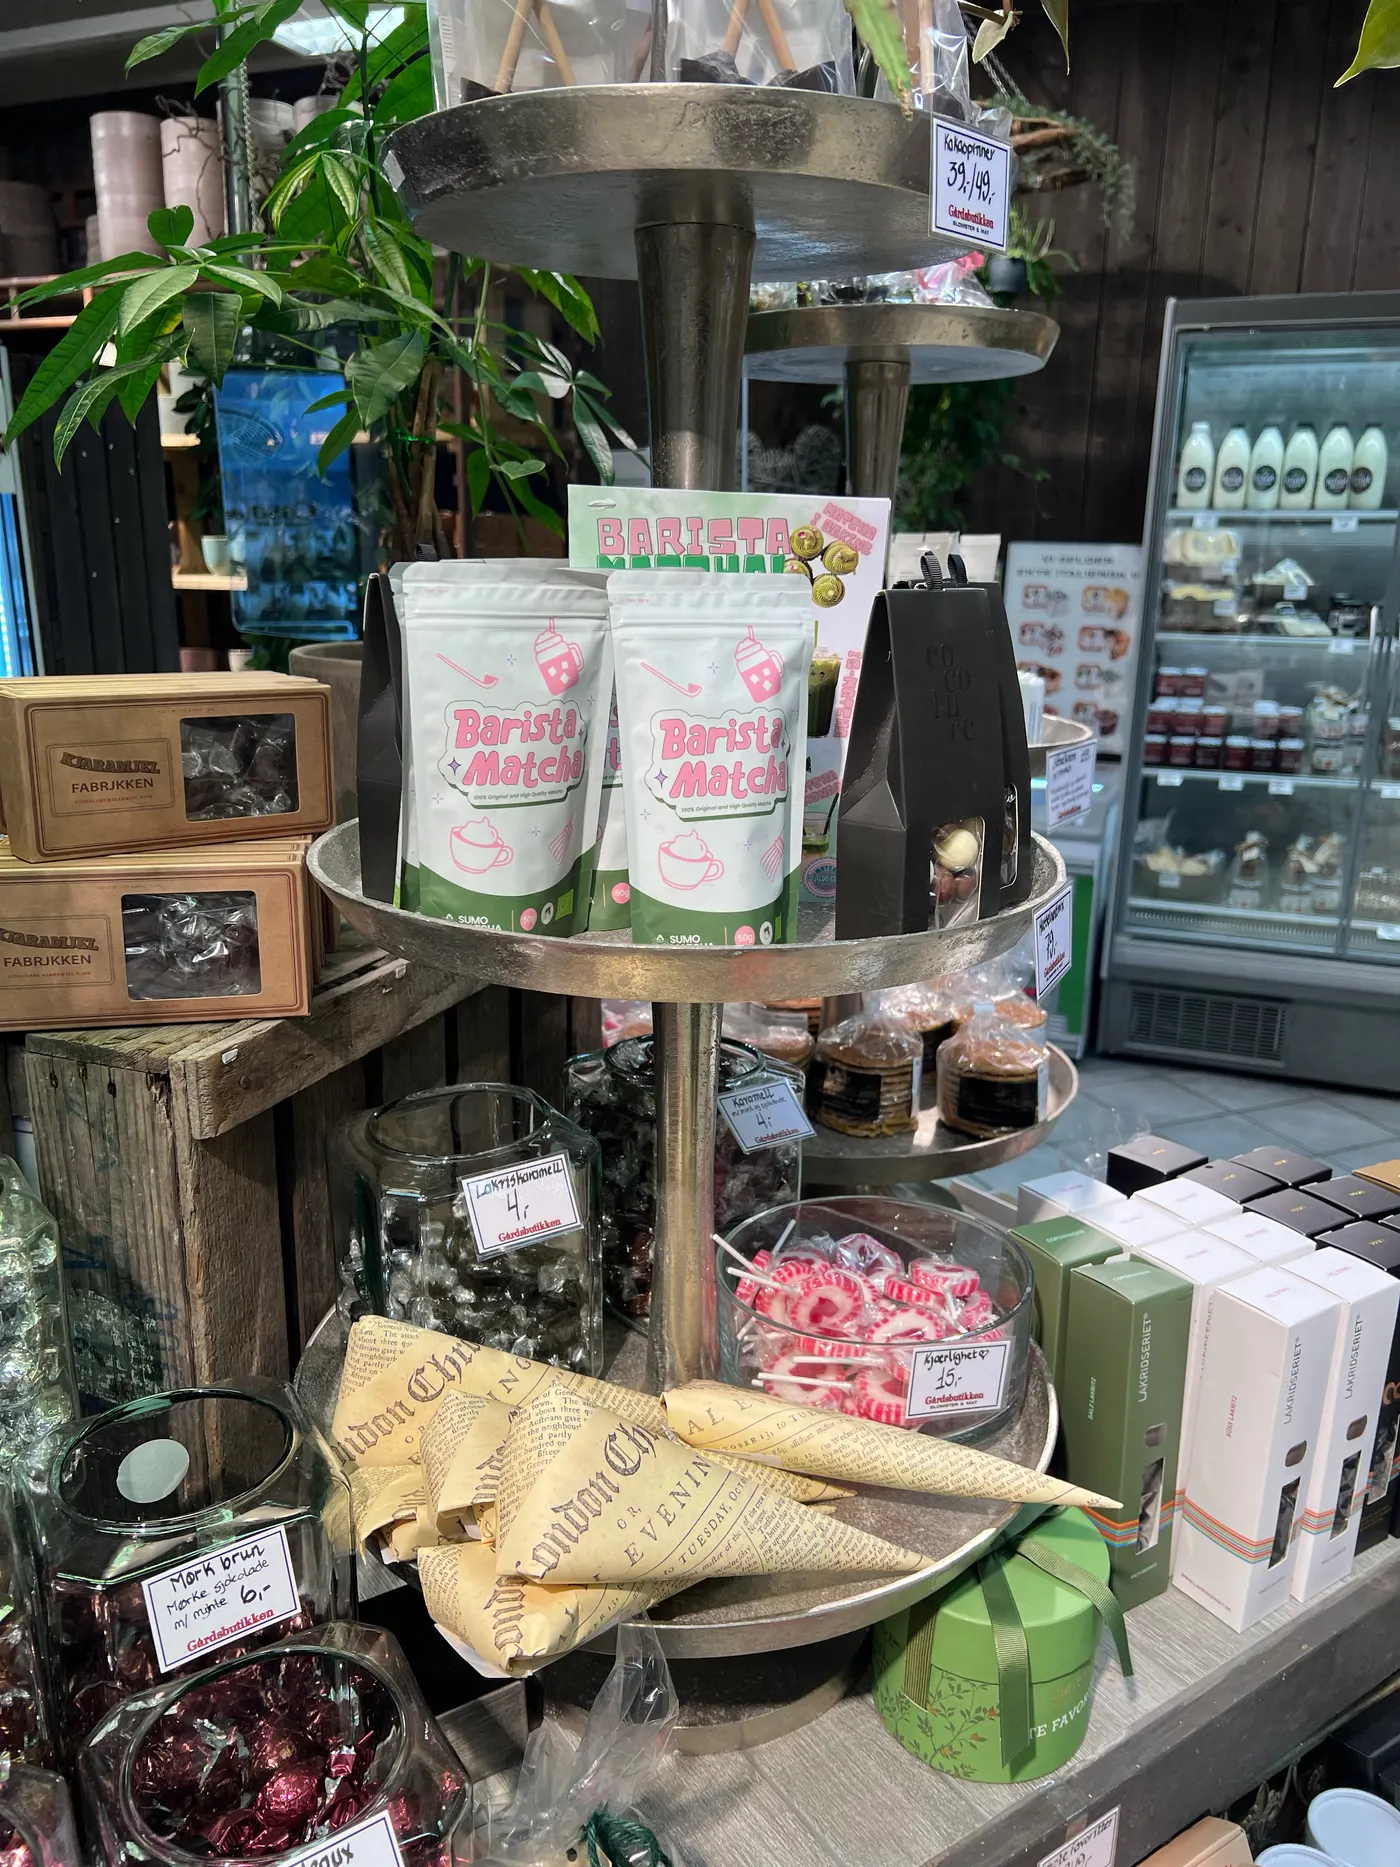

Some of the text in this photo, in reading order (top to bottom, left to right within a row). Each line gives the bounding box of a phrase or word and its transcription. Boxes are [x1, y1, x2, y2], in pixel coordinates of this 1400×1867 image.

[948, 204, 994, 229] Gårdsbutikken
[823, 501, 877, 540] MATCHA
[597, 517, 791, 555] BARISTA
[454, 708, 577, 749] Barista
[659, 715, 784, 760] Barista
[462, 744, 583, 788] Matcha
[695, 805, 717, 813] Original
[458, 915, 488, 925] SUMO
[670, 934, 701, 944] SUMO
[755, 1128, 800, 1144] Gårdsbutikken
[498, 1219, 562, 1242] Gårdsbutikken
[560, 1406, 581, 1414] three
[925, 1392, 984, 1405] Gårdsbutikken
[1228, 1395, 1237, 1421] LAKRITZ
[548, 1431, 572, 1440] partly
[776, 1421, 787, 1430] to
[905, 1452, 916, 1461] the
[993, 1472, 1024, 1492] and could
[1025, 1486, 1038, 1495] the
[679, 1503, 732, 1564] TUESDAY,
[219, 1544, 266, 1572] brun
[174, 1584, 271, 1630] m/ mynte 6,-
[187, 1608, 275, 1652] Gårdsbutikken
